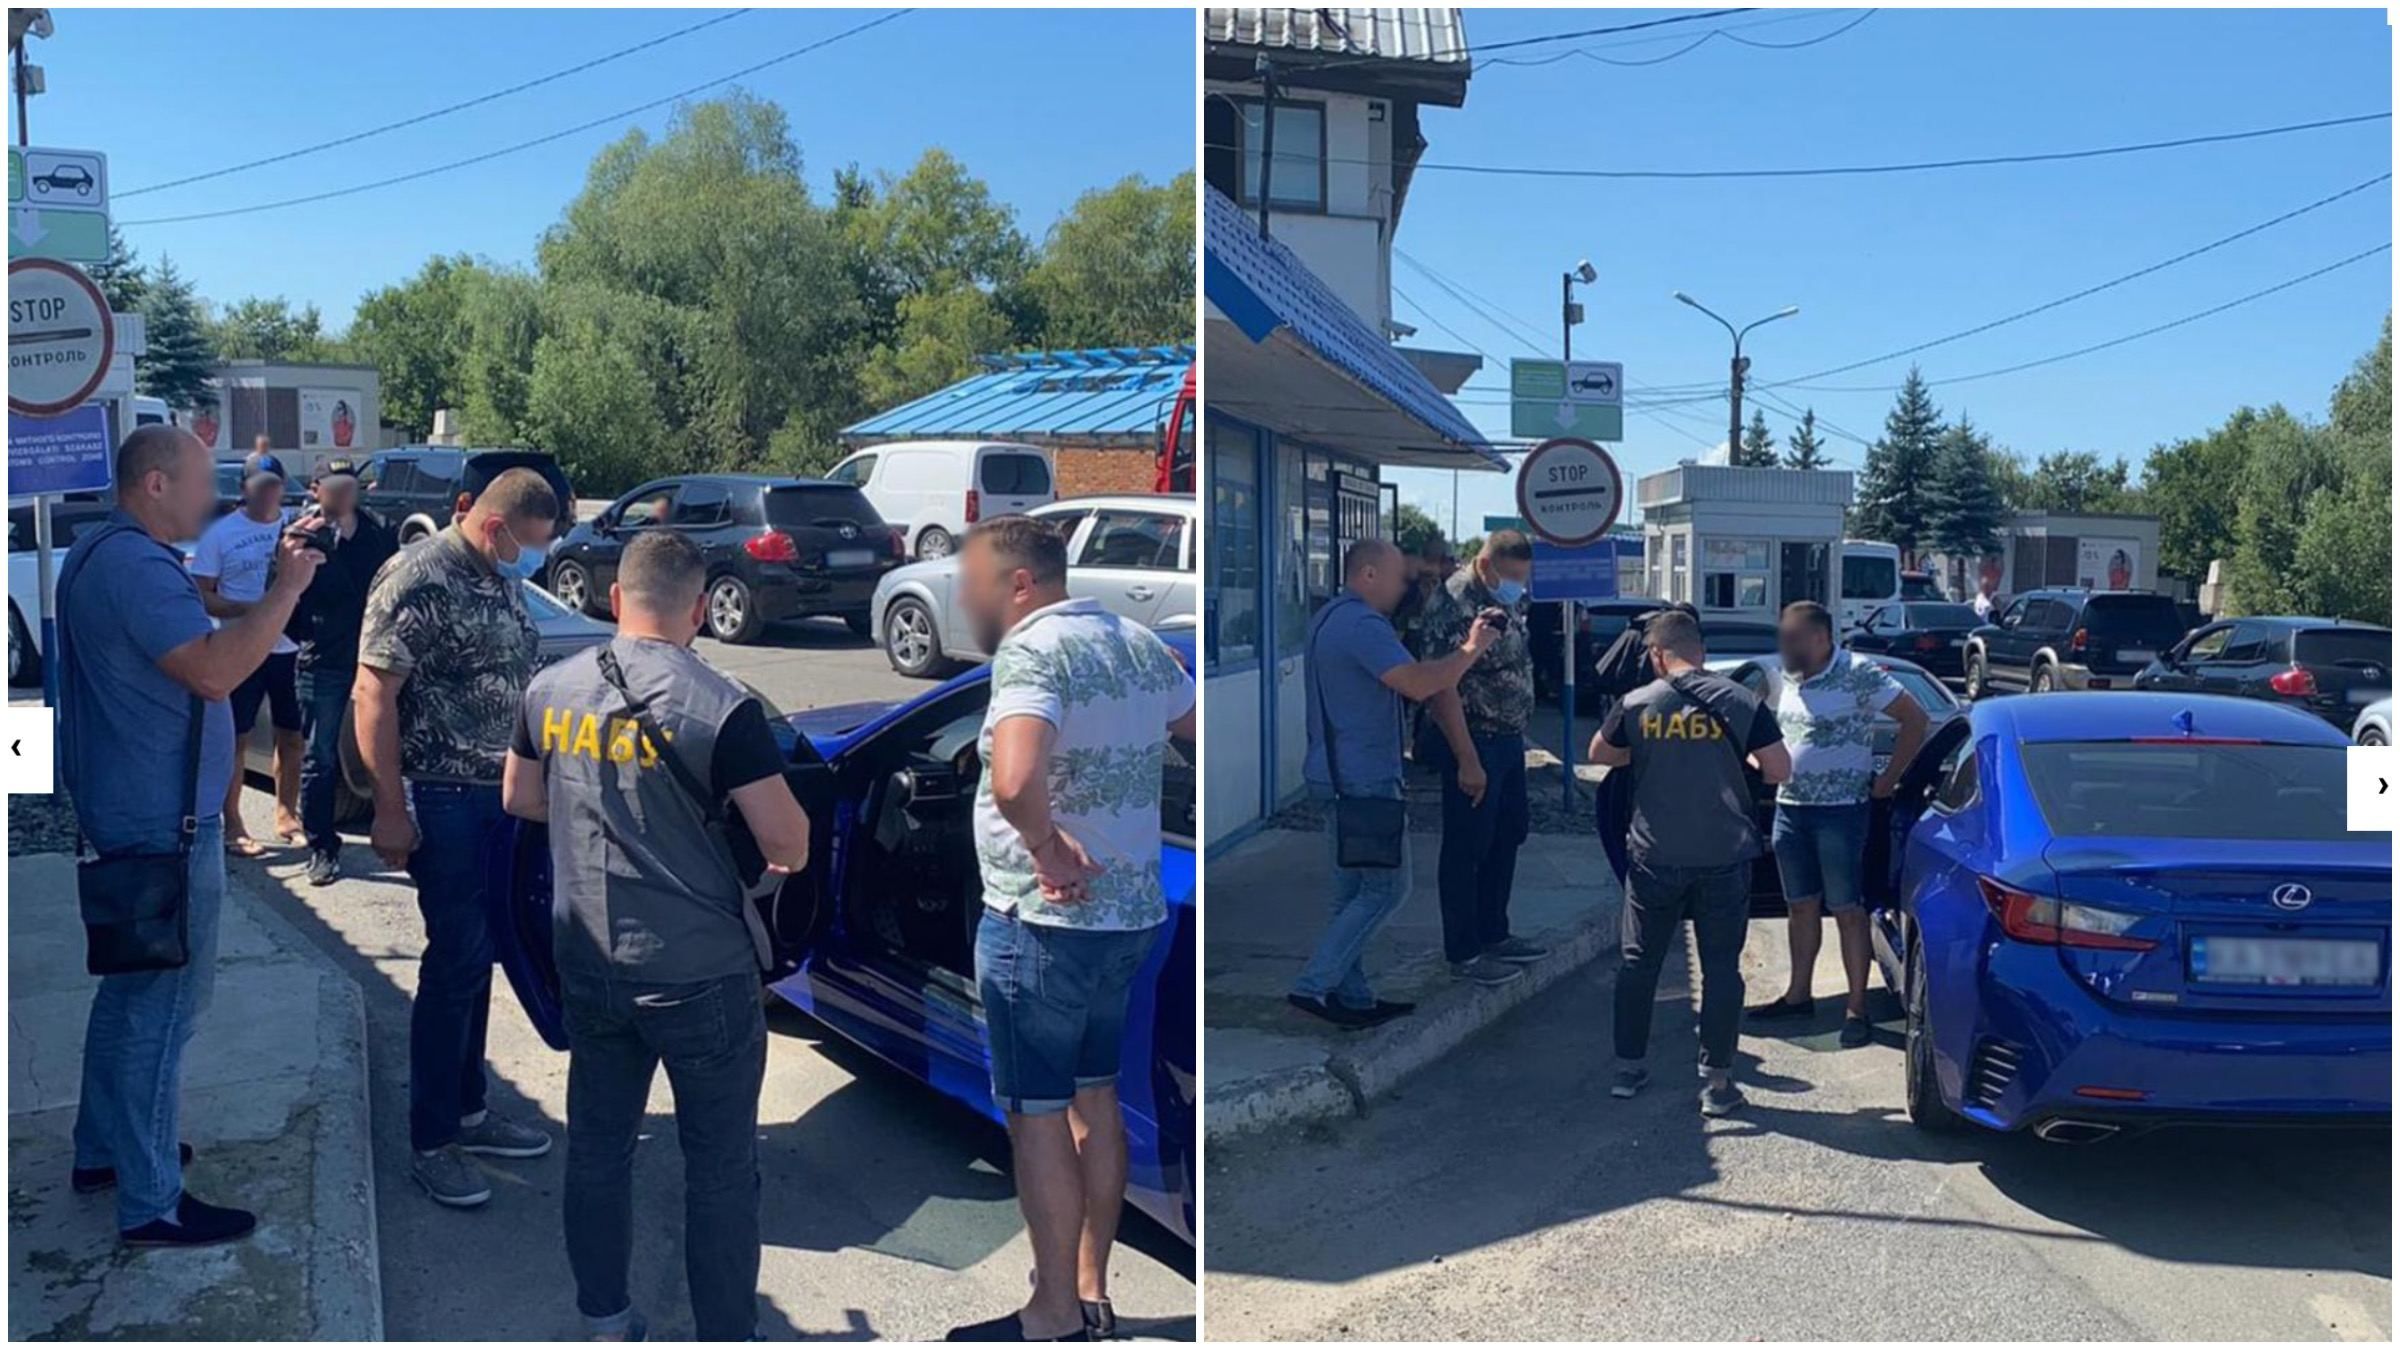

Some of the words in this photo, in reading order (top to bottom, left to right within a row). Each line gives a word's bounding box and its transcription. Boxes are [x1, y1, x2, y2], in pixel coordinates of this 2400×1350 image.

[10, 297, 65, 323] STOP
[8, 350, 86, 368] ОНТРОЛЬ
[1548, 464, 1588, 482] STOP
[1541, 501, 1602, 513] КОНТРОЛЬ
